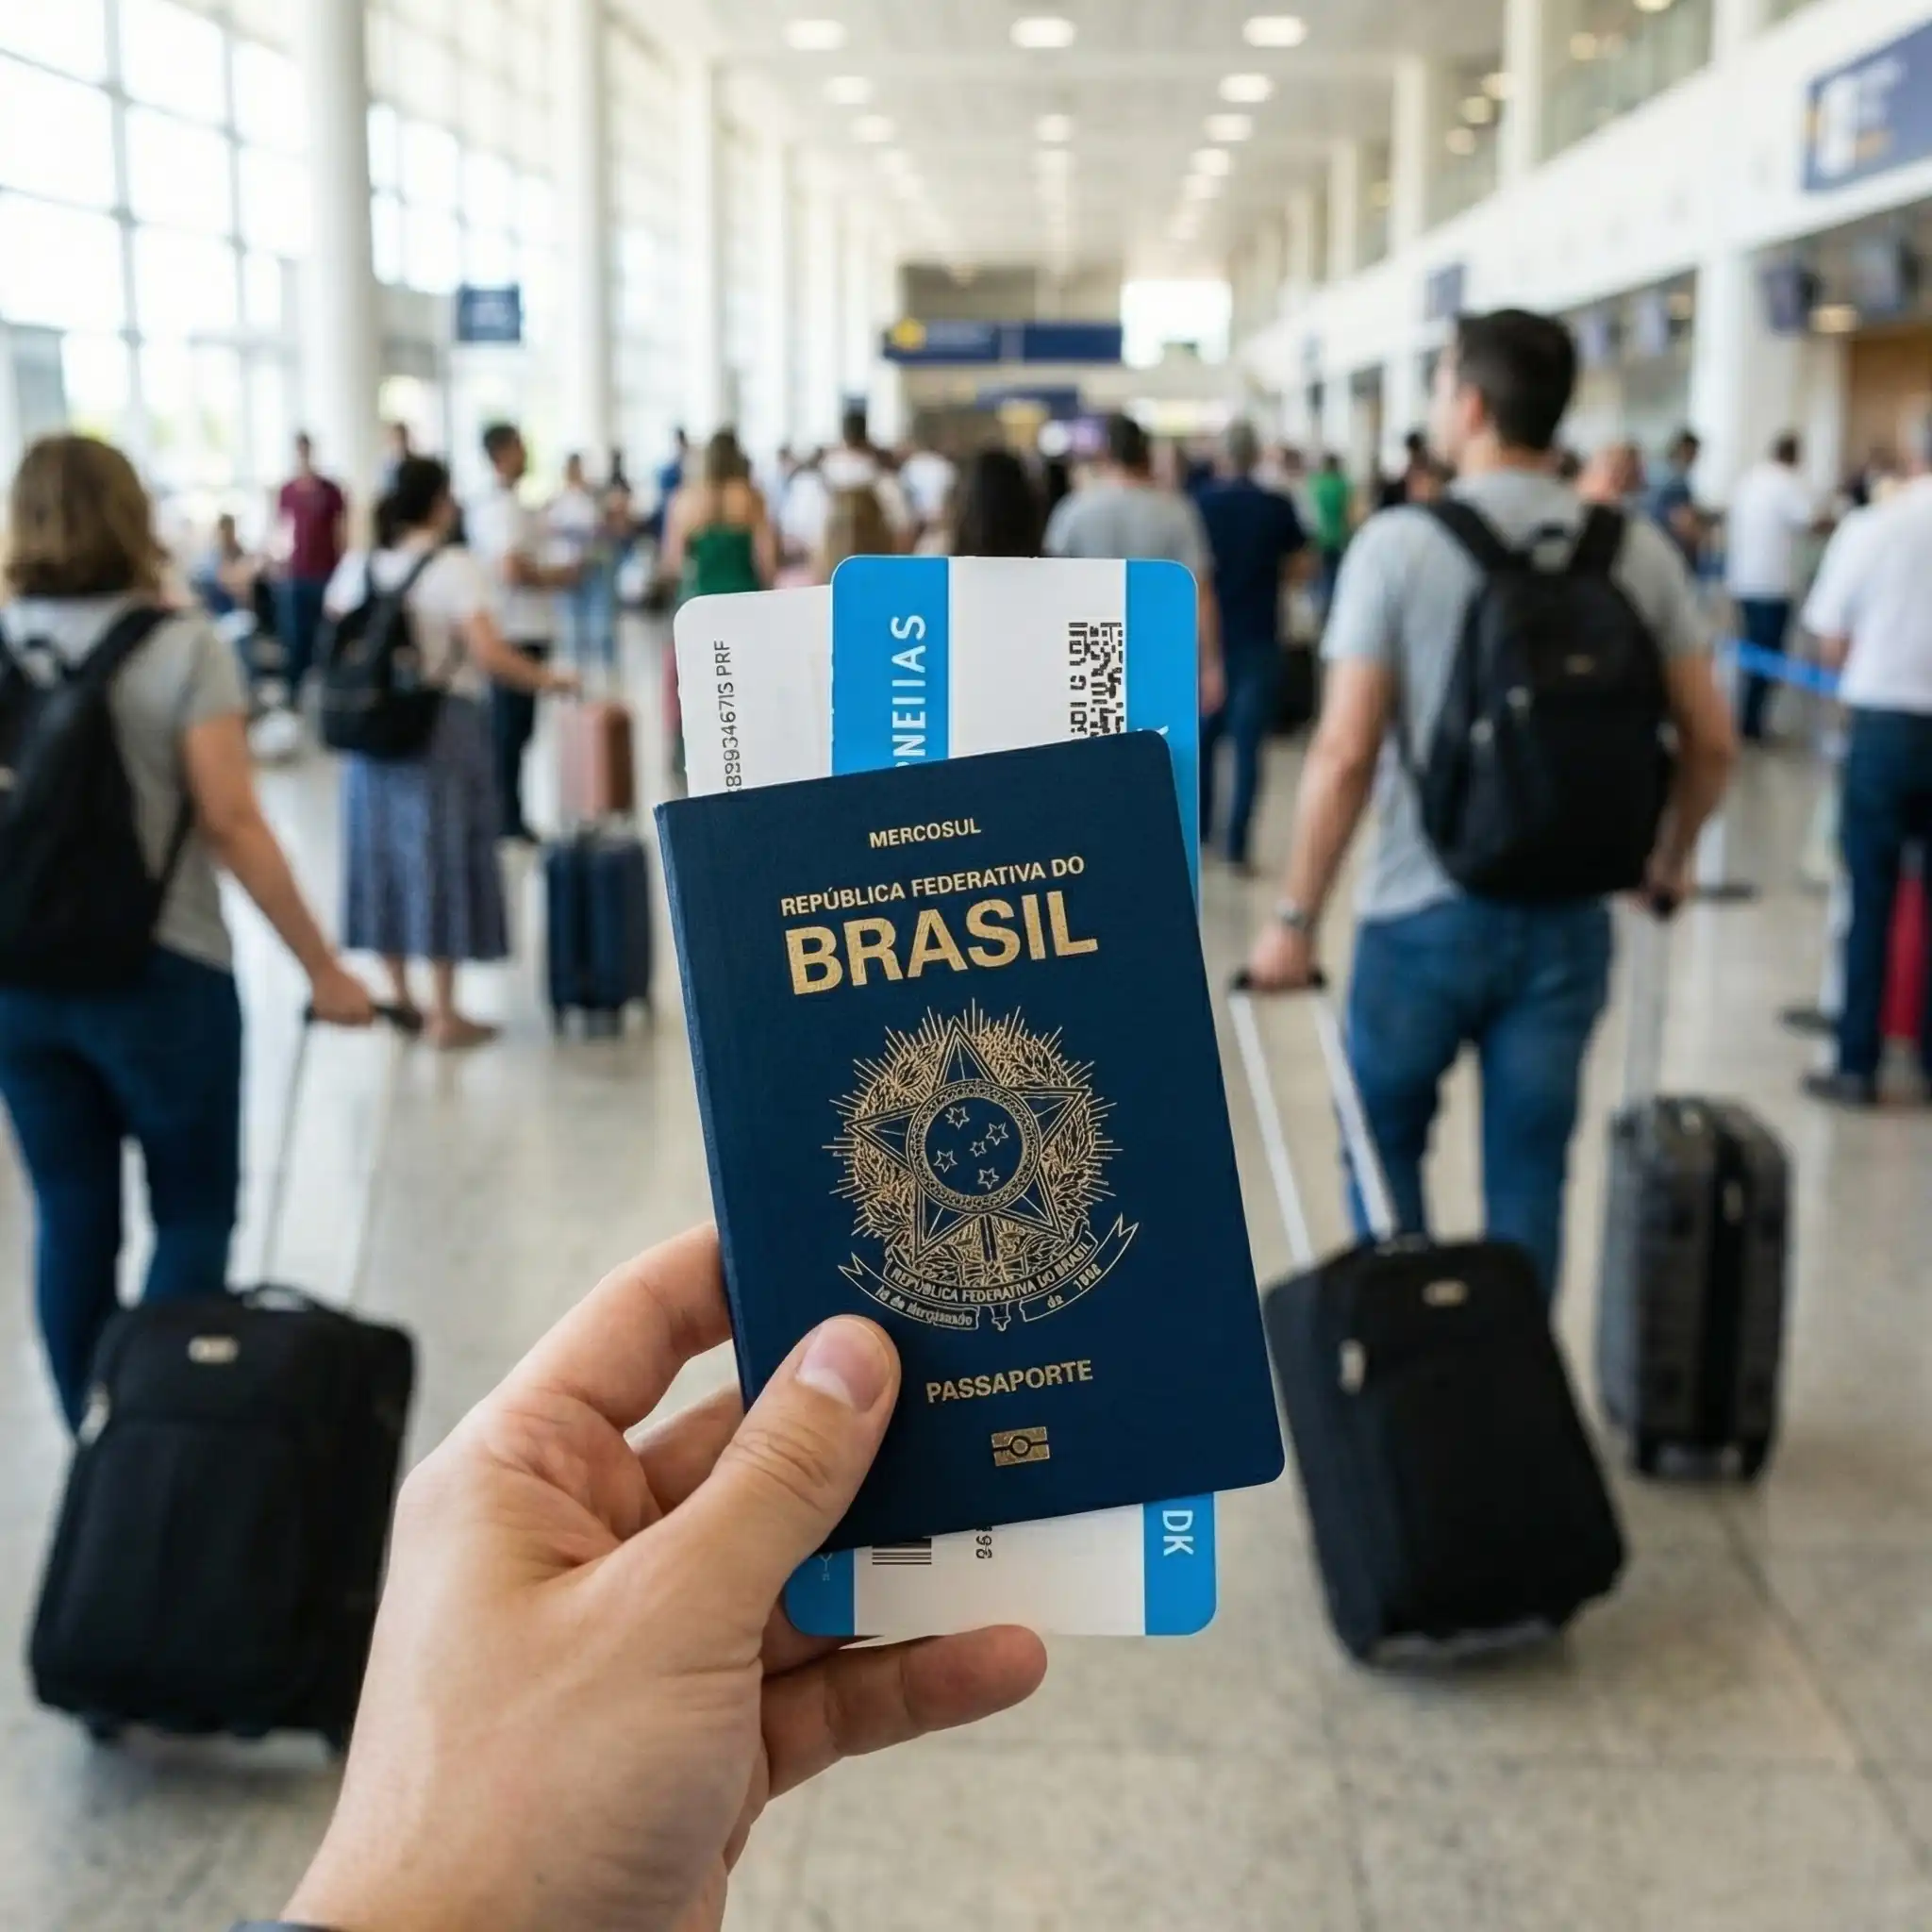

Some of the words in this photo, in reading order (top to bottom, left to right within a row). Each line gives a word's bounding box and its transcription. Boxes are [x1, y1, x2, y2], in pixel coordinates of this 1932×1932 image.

[713, 641, 732, 676] PRF
[891, 615, 926, 767] NEIIAS
[869, 817, 981, 848] MERCOSUL
[780, 881, 906, 917] REPÚBLICA
[911, 861, 1046, 898] FEDERATIVA
[1052, 856, 1084, 877] DO
[784, 890, 1098, 995] BRASIL
[925, 1359, 1093, 1403] PASSAPORTE
[1162, 1509, 1194, 1557] DK
